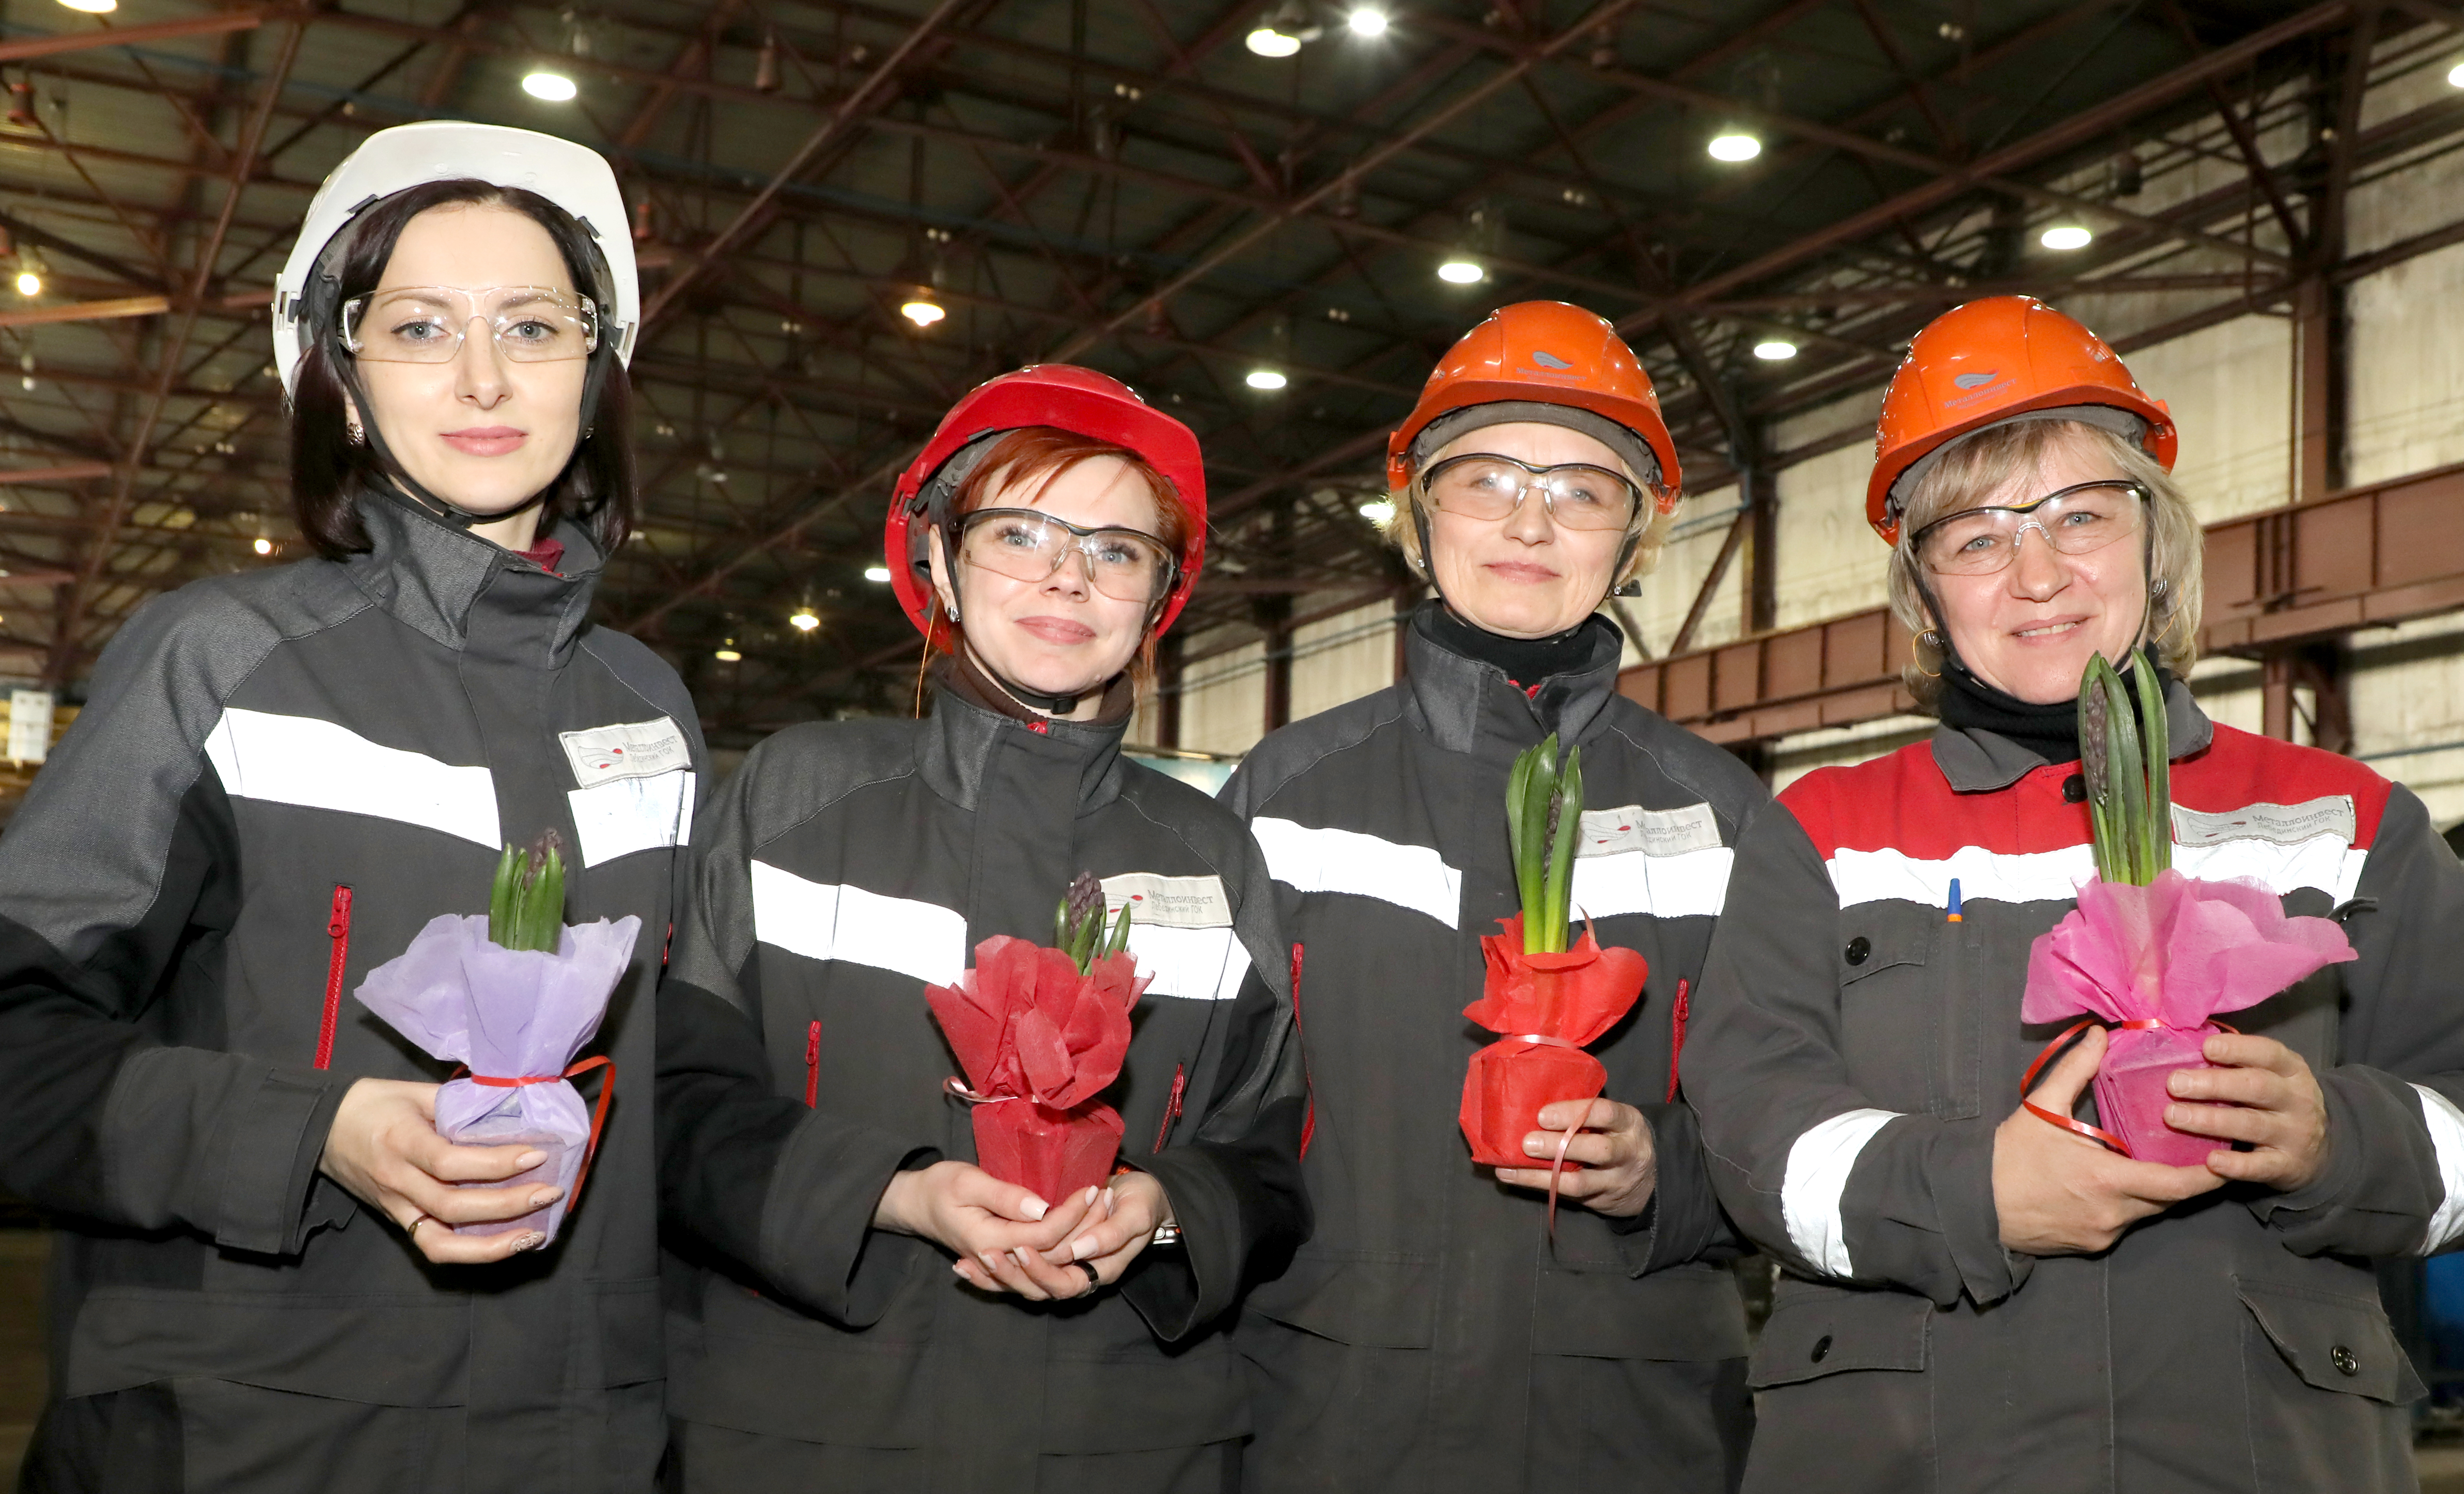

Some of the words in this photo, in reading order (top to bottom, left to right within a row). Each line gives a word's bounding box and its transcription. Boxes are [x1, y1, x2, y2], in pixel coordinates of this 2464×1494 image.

[659, 746, 674, 756] ГОК
[2252, 809, 2344, 827] Металлоинвест
[1635, 820, 1702, 834] Маллоинвест
[2257, 822, 2312, 835] Лебединский
[2314, 816, 2331, 826] ГОК
[1678, 831, 1692, 840] ГОК
[1147, 889, 1213, 904] Металлоинвест
[1152, 901, 1189, 913] Лебединский
[1191, 905, 1203, 914] ГОК
